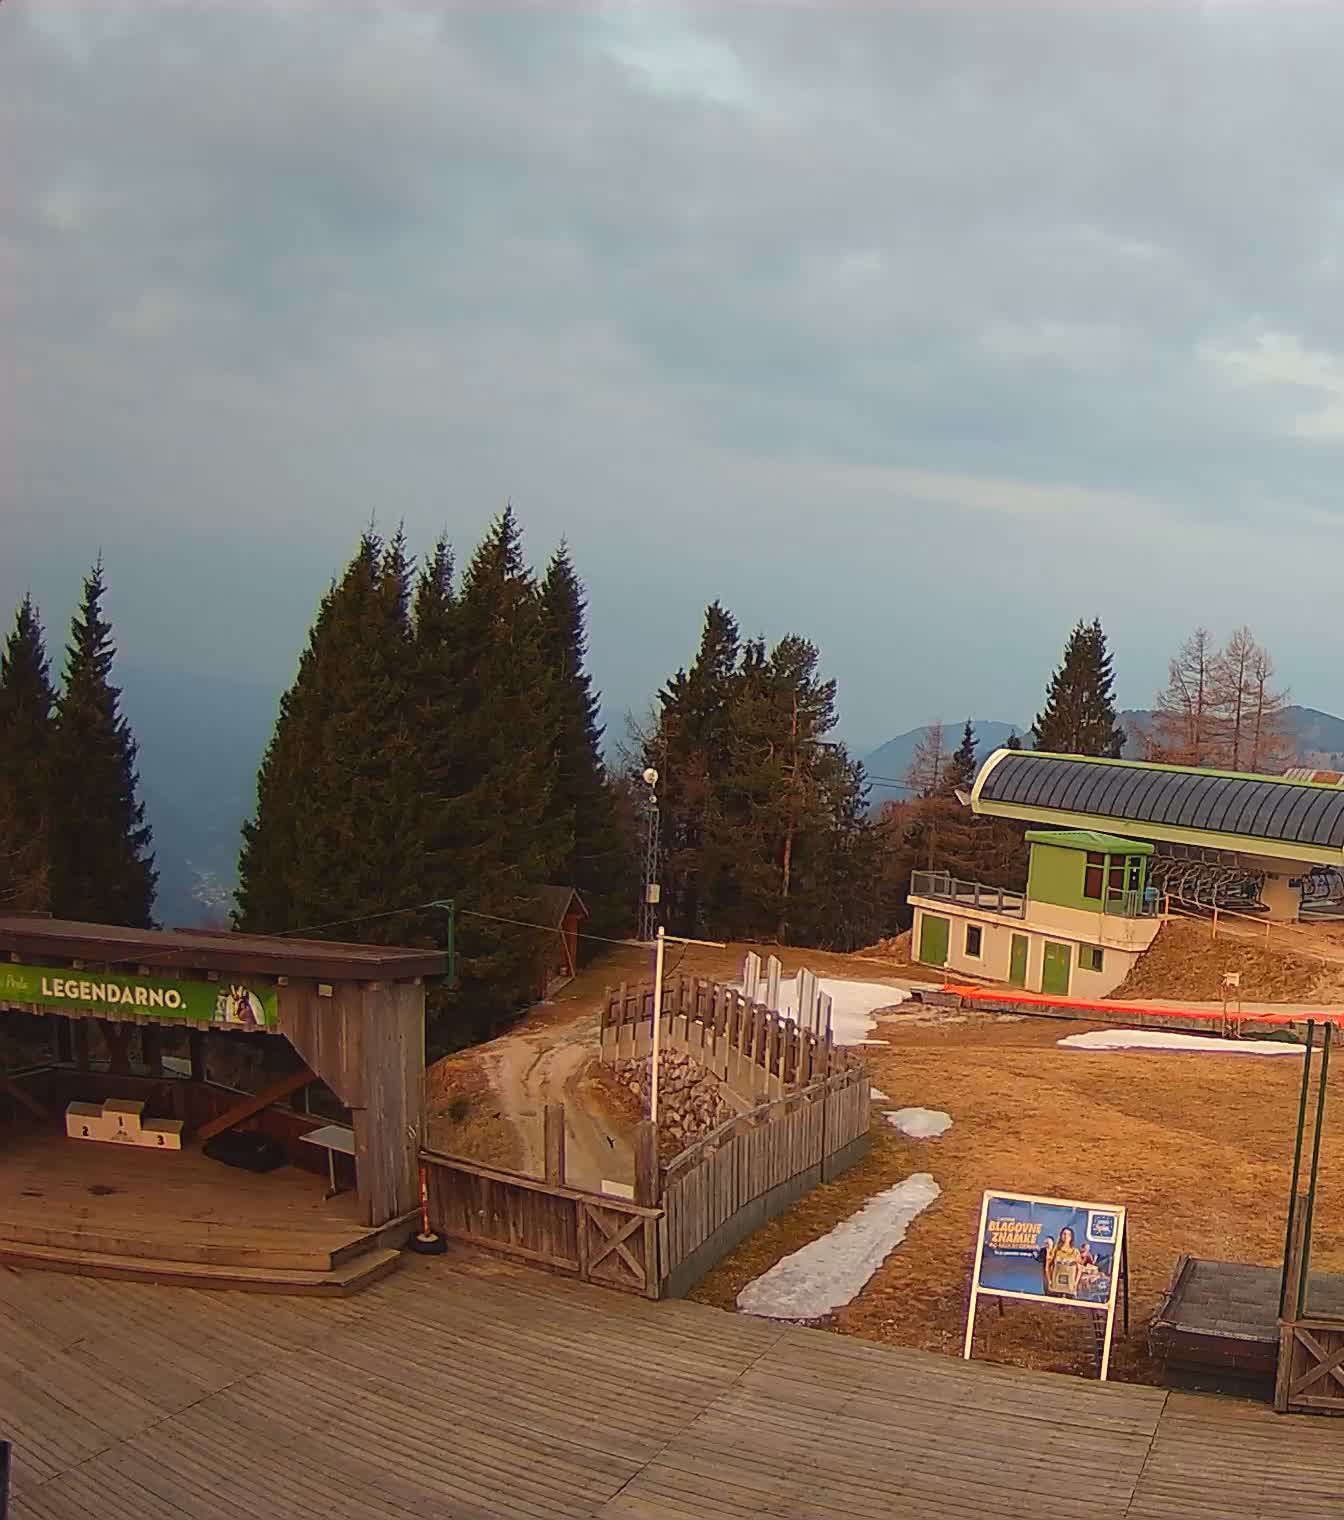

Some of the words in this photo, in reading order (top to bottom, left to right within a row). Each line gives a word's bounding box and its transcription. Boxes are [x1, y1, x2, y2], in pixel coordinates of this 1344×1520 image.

[41, 977, 187, 1009] LEGENDARNO.
[117, 1116, 124, 1126] 1
[81, 1126, 89, 1136] 2
[156, 1135, 165, 1146] 3
[991, 1232, 1038, 1244] ZNAMKE
